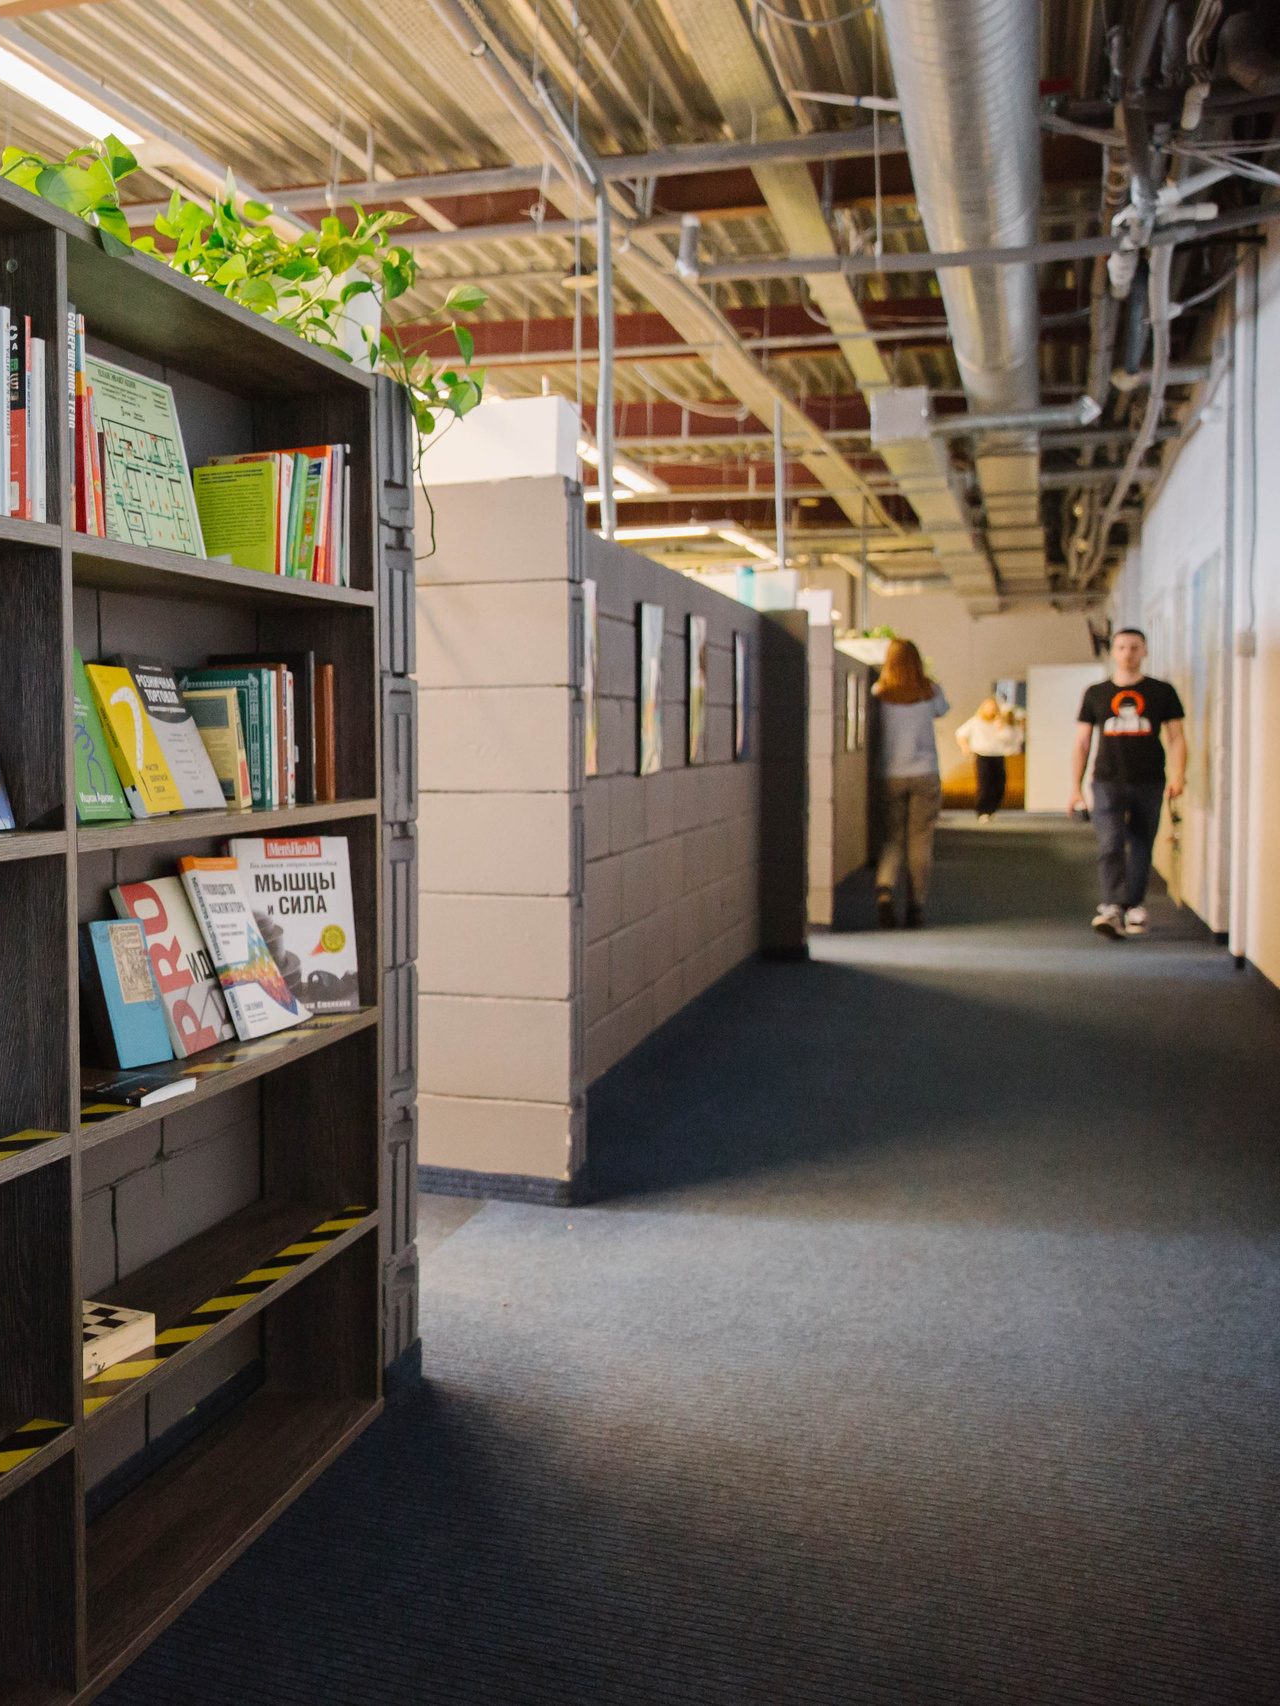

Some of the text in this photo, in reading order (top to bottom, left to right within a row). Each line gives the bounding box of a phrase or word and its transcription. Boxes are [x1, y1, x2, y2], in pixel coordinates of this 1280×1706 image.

[67, 312, 76, 397] СОВЕРШЕННОЕ
[135, 674, 176, 690] РОЗНИЧНАЯ
[144, 689, 179, 704] ТОРГОВЛЯ
[254, 872, 336, 894] МЫШЦЫ
[267, 895, 327, 916] и СИЛА
